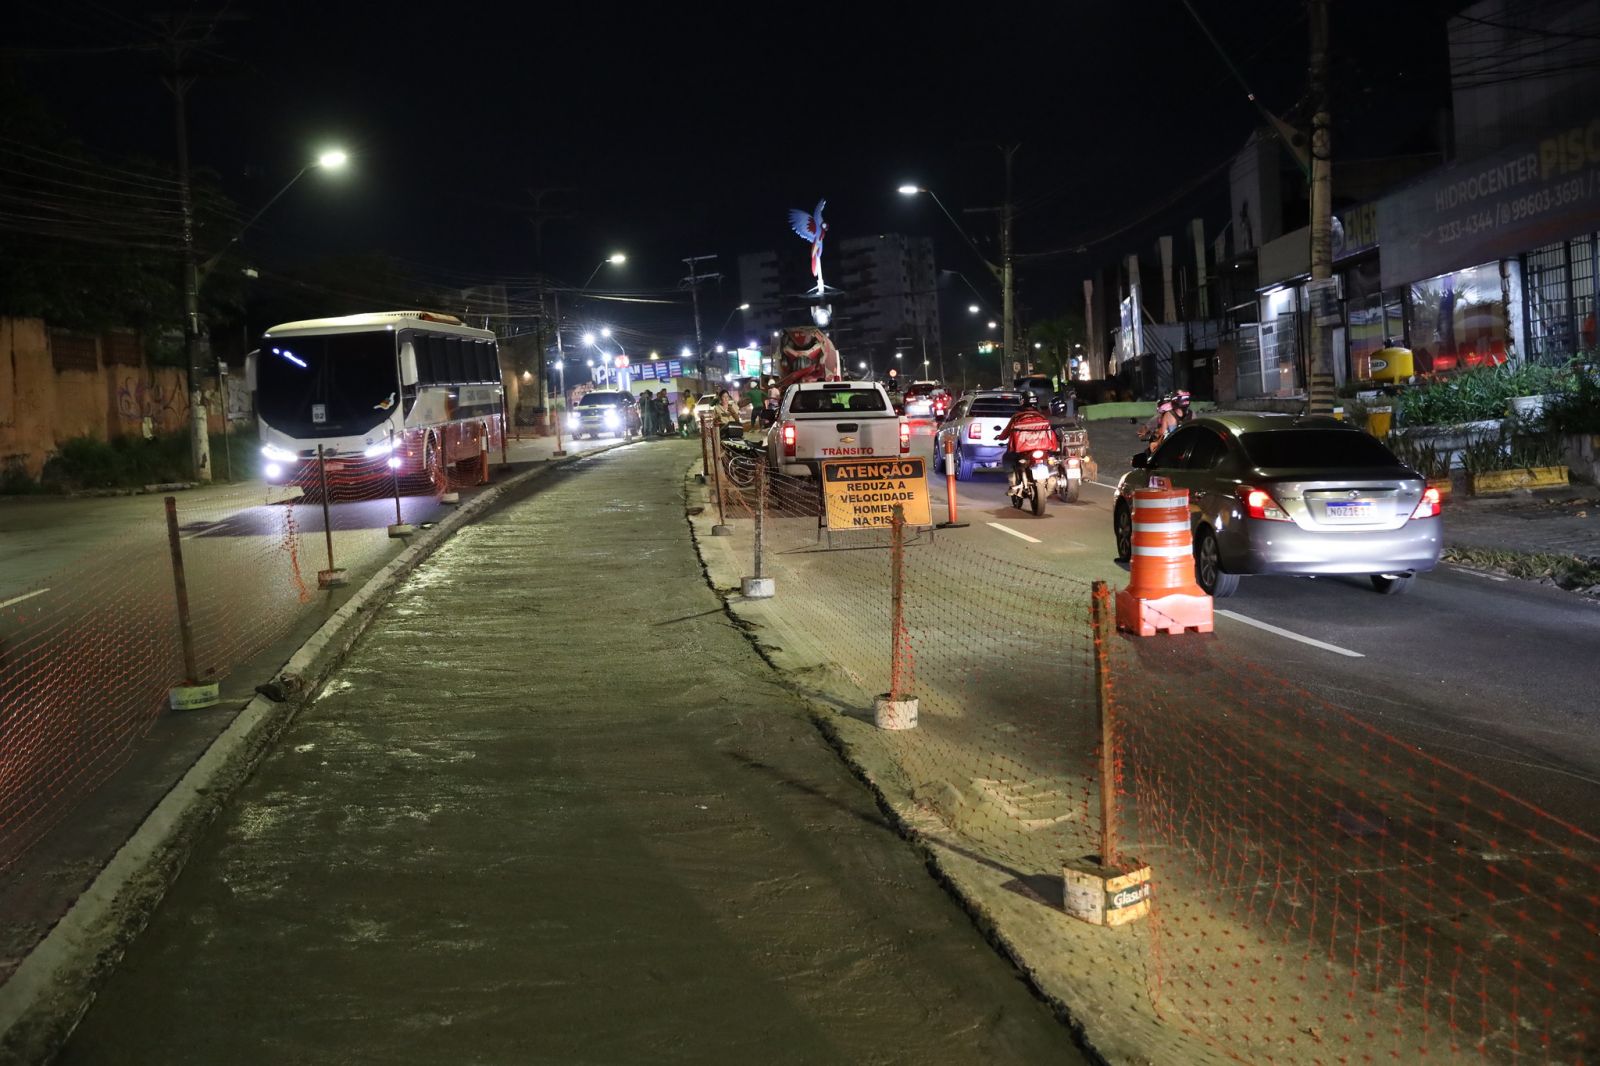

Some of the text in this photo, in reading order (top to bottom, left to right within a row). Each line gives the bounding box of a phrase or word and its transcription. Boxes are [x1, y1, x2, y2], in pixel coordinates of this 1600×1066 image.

[1435, 152, 1538, 213] HIDROCENTER
[836, 462, 913, 479] ATENÇÃO
[847, 481, 906, 491] REDUZA A
[841, 492, 914, 503] VELOCIDADE
[854, 504, 896, 514] HOMEN
[853, 517, 870, 525] NA
